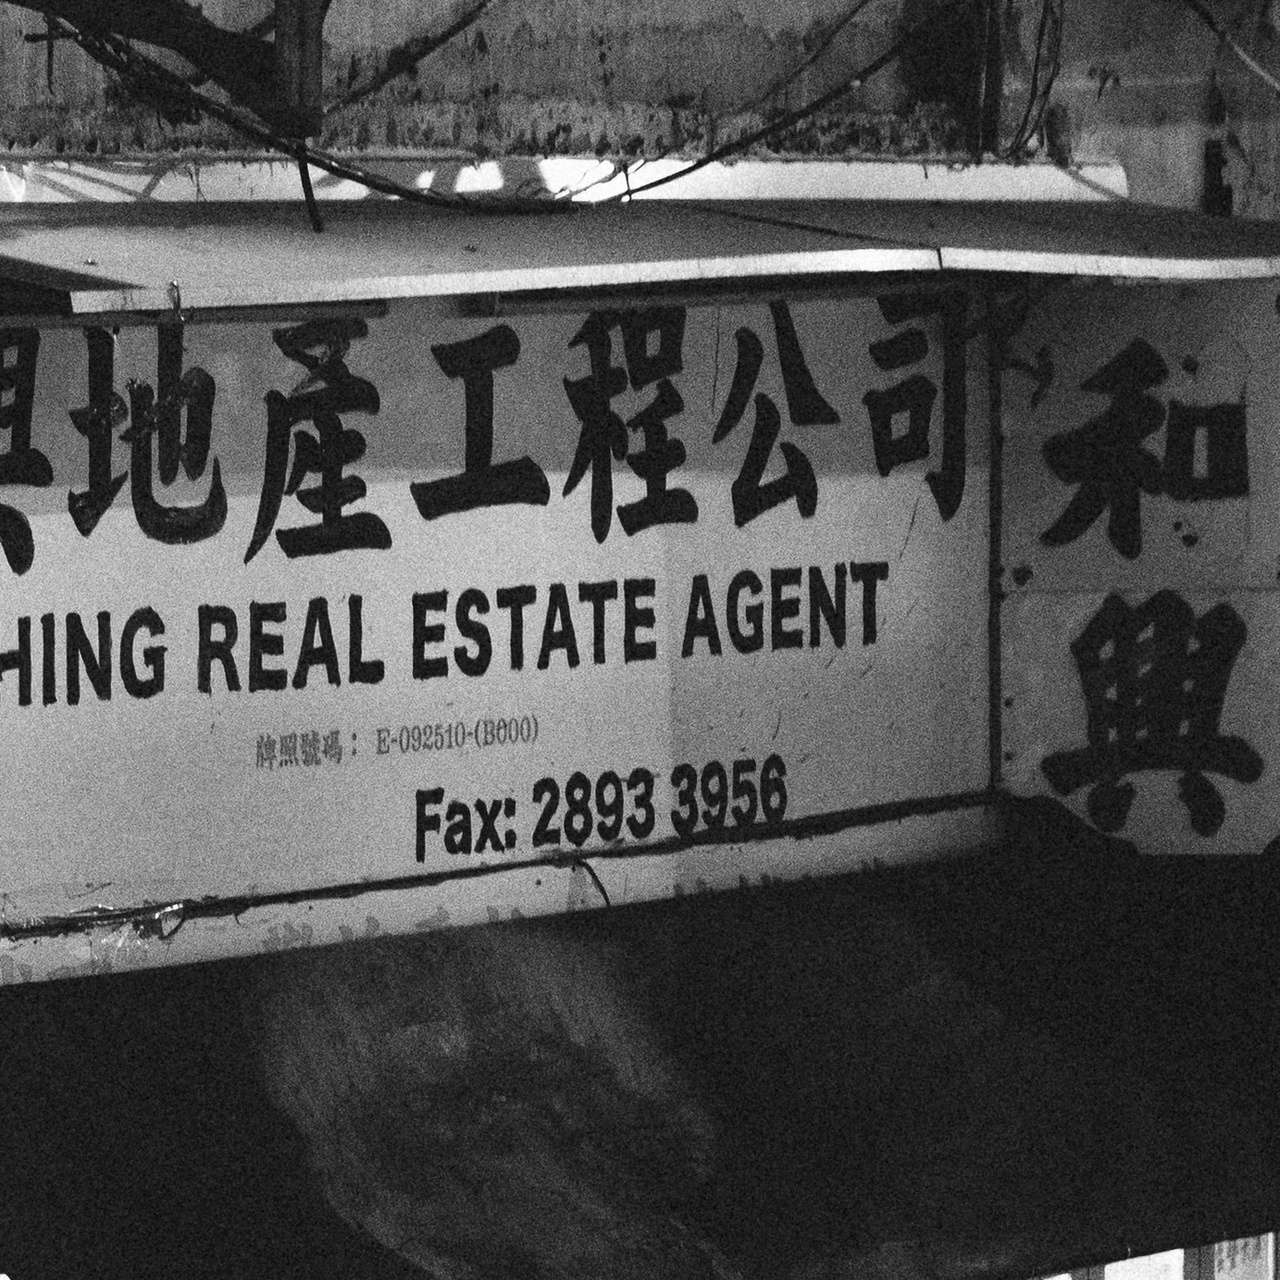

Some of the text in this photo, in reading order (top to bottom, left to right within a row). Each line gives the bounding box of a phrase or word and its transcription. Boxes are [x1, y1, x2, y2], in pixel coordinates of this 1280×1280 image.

[196, 592, 386, 695] REAL
[411, 577, 658, 681] ESTATE
[680, 559, 891, 659] AGENT
[1041, 337, 1264, 838] 和興
[414, 753, 789, 863] Fax: 2893 3956
